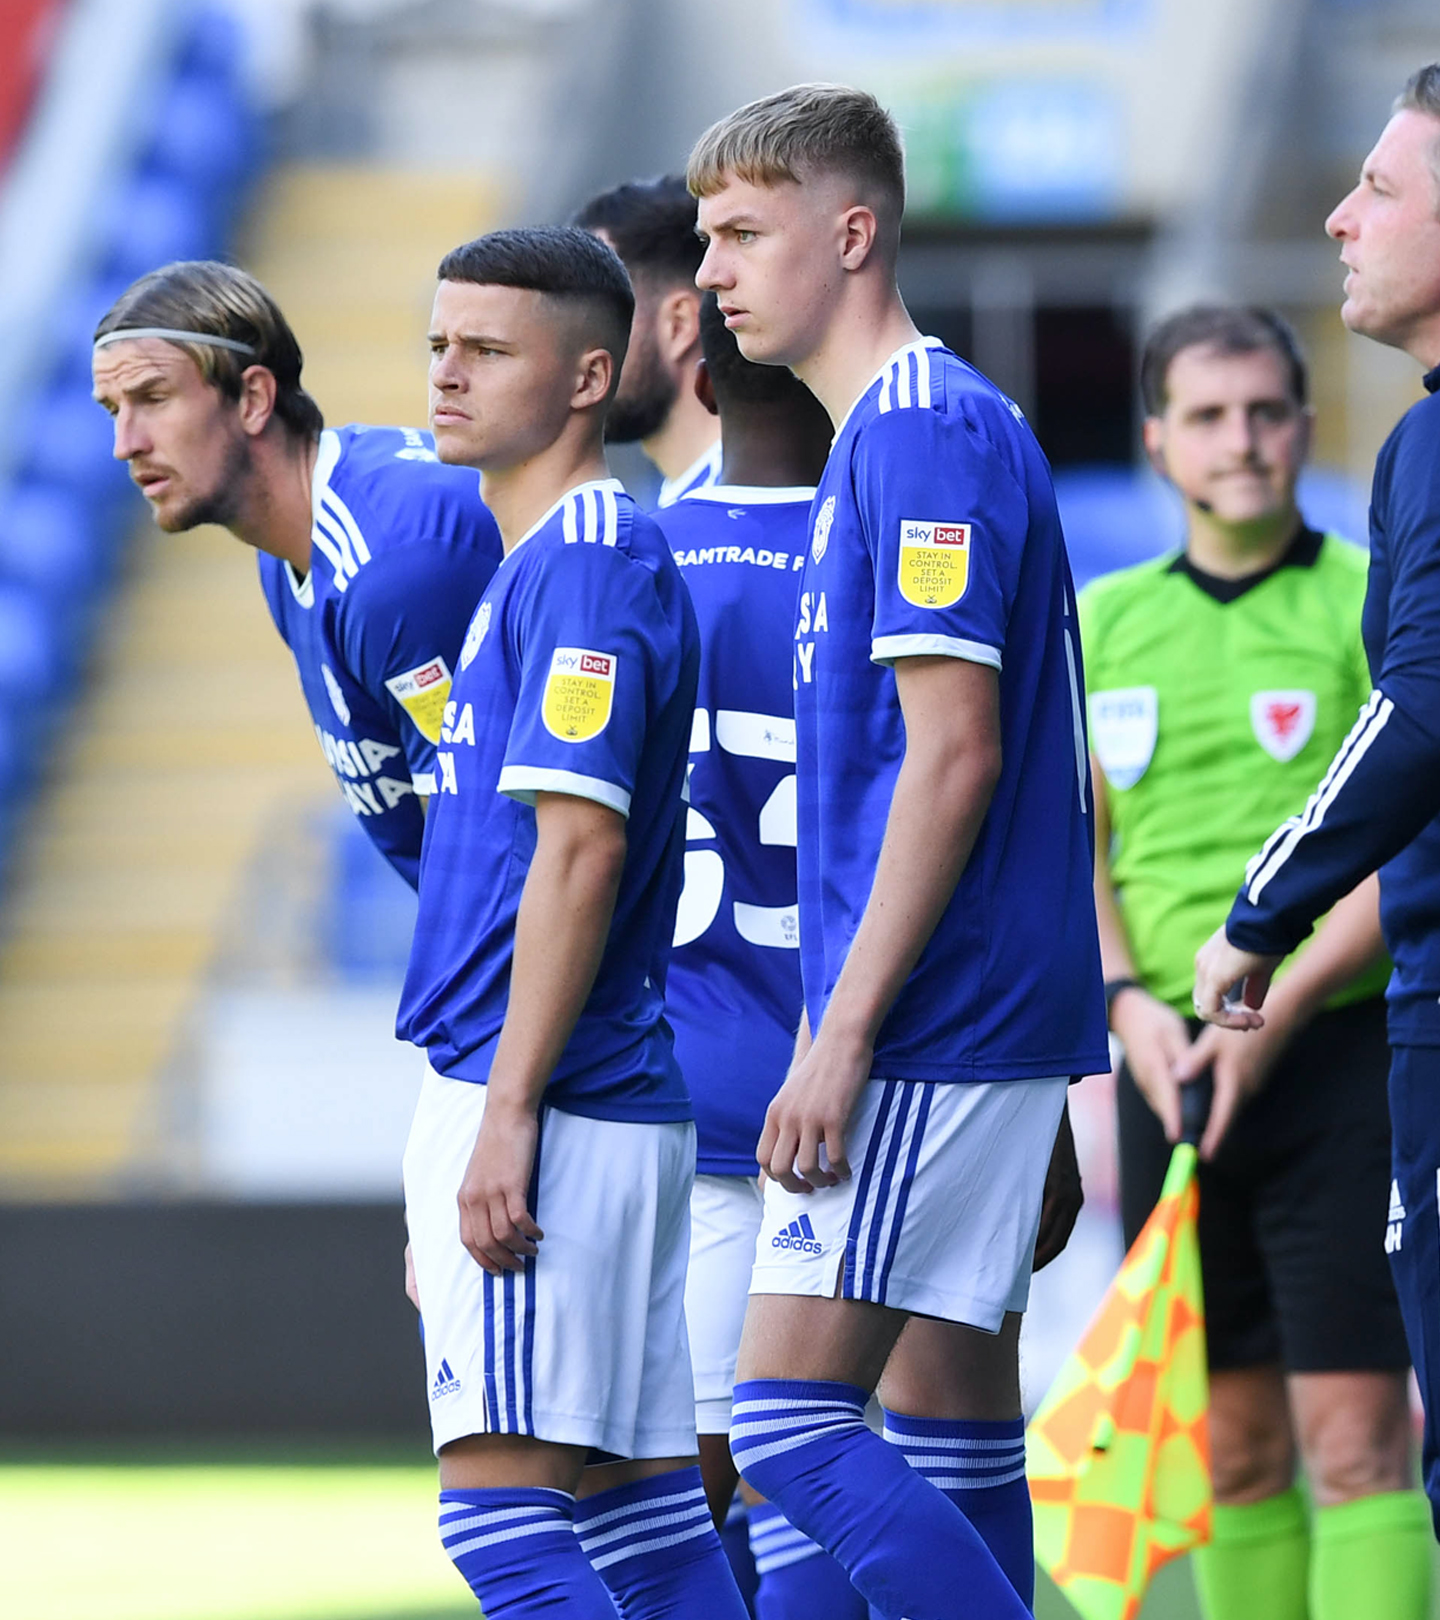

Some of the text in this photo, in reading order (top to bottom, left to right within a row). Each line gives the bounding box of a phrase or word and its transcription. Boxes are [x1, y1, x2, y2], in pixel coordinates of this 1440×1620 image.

[906, 526, 962, 542] sky bet
[673, 546, 789, 570] SAMTRADE
[916, 551, 951, 560] STAY IN
[920, 568, 945, 577] SET A
[912, 576, 952, 586] DEPOSIT
[919, 585, 945, 593] LIMIT
[556, 654, 608, 673] sky bet
[562, 678, 597, 689] STAY IN
[564, 695, 580, 704] SET
[555, 704, 596, 715] DEPOSIT
[561, 713, 587, 723] LIMIT
[771, 1235, 823, 1255] adidas
[431, 1379, 461, 1402] adidas
